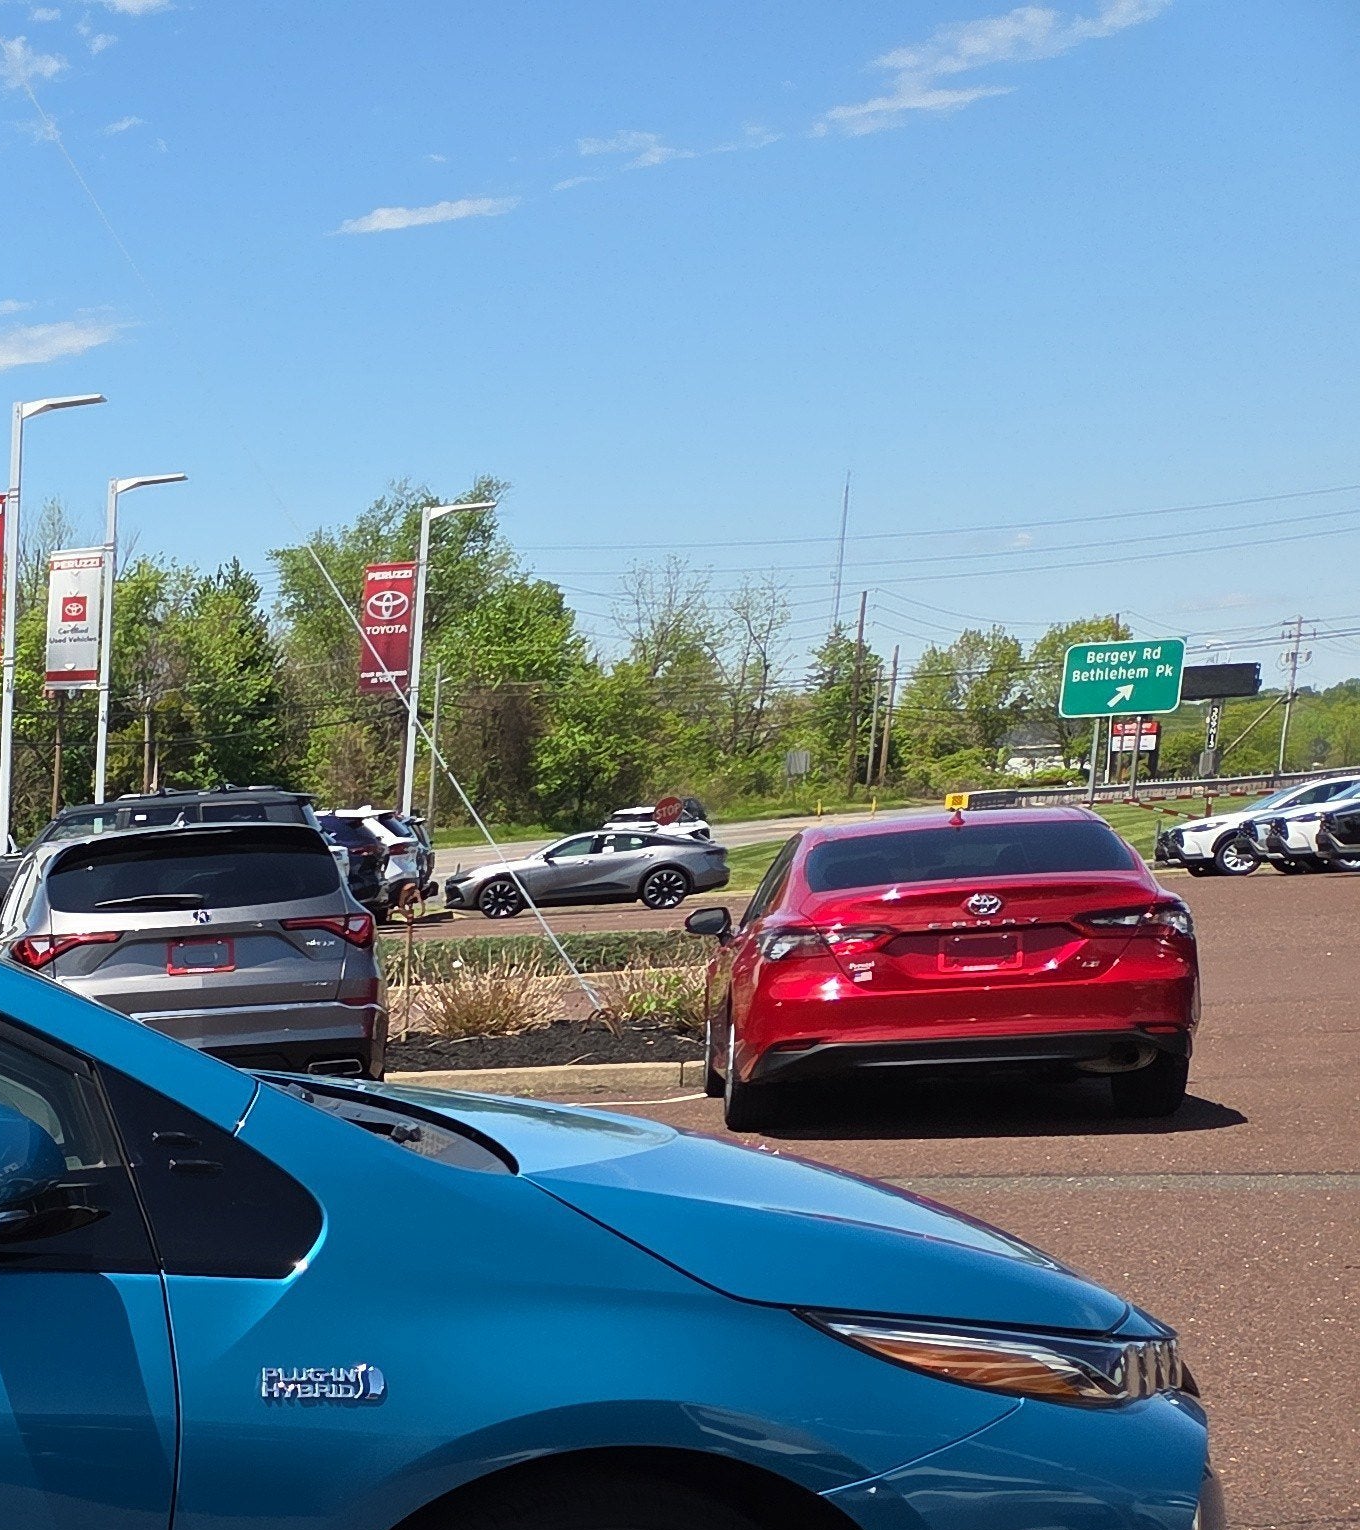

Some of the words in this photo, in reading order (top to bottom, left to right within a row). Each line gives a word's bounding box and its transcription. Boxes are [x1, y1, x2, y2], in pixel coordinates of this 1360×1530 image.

[365, 624, 408, 635] TOYOTA
[1086, 650, 1137, 665] Bergey
[1142, 646, 1162, 660] Rd
[1072, 666, 1149, 683] Bethlehem
[1155, 663, 1174, 678] Pk
[655, 803, 681, 820] STOP
[262, 1366, 356, 1382] PLUG-IN
[262, 1381, 355, 1399] HYBRID
